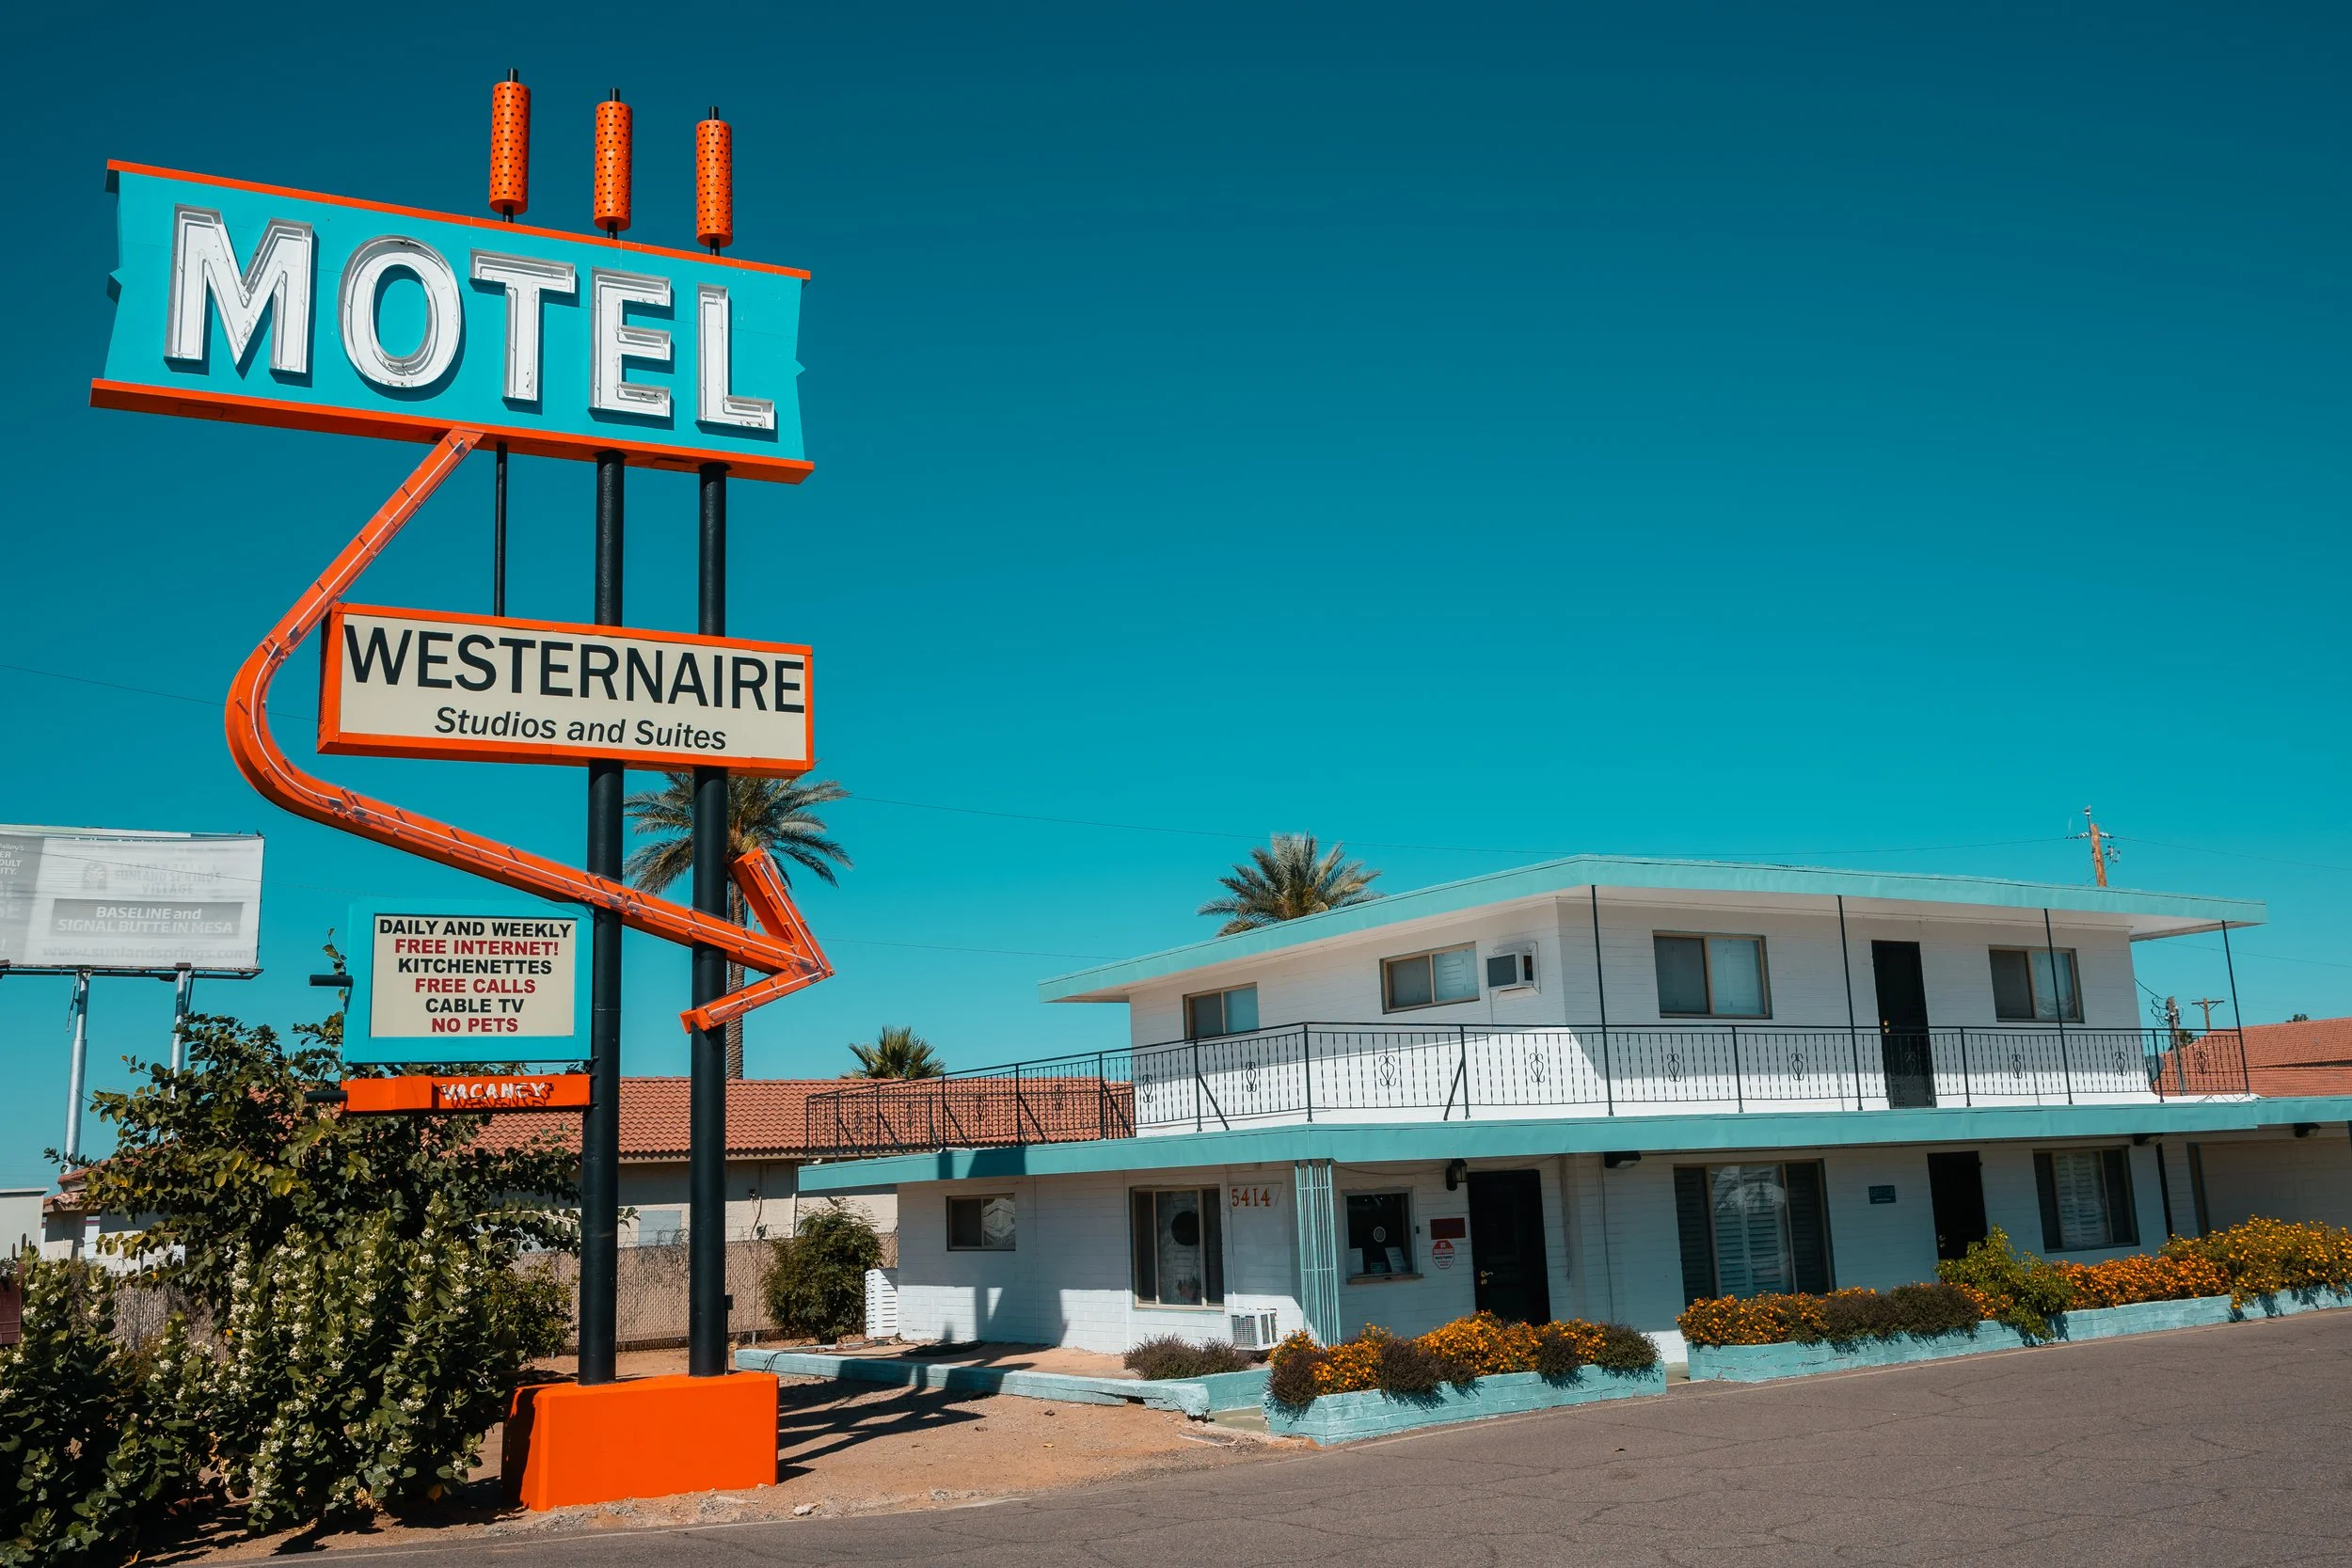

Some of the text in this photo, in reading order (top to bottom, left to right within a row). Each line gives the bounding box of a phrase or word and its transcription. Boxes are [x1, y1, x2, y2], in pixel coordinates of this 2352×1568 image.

[164, 203, 776, 431] MOTEL
[343, 625, 805, 713] WESTERNAIRE
[435, 706, 727, 751] Studios and Suites
[96, 906, 202, 920] BASELINE and
[56, 918, 233, 934] SIGNAL BUTTE IN MESA
[379, 919, 572, 939] DAILY AND WEEKLY
[42, 946, 248, 960] www.sunlandsprings.com
[394, 939, 559, 956] FREE INTERNET!
[398, 958, 552, 974] KITCHENETTES
[415, 978, 536, 993] FREE CALLS
[425, 998, 525, 1013] CABLE TV
[432, 1018, 518, 1033] NO PETS
[441, 1082, 547, 1101] VACANCY
[1231, 1187, 1271, 1208] 5414
